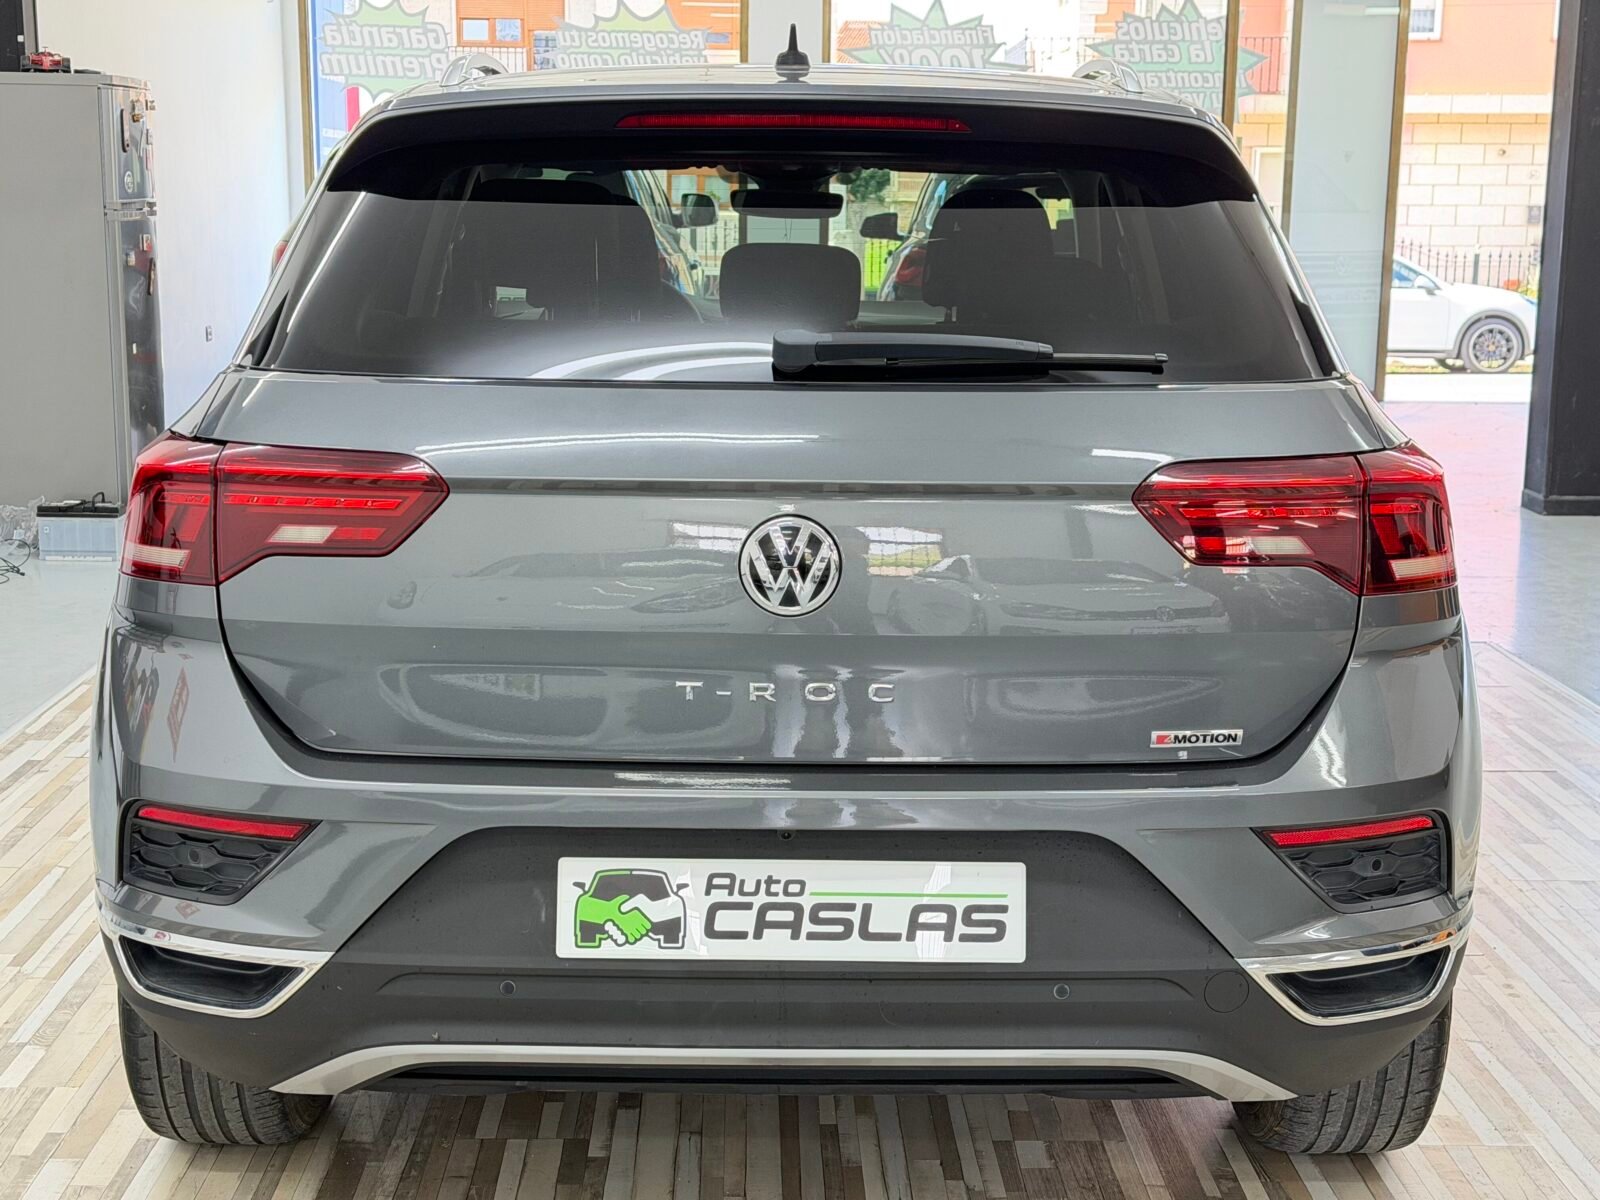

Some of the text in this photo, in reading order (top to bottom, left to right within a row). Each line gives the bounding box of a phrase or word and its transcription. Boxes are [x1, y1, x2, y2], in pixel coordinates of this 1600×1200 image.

[675, 681, 896, 702] T-ROC
[704, 872, 807, 897] Auto
[703, 901, 1010, 943] CASLAS
